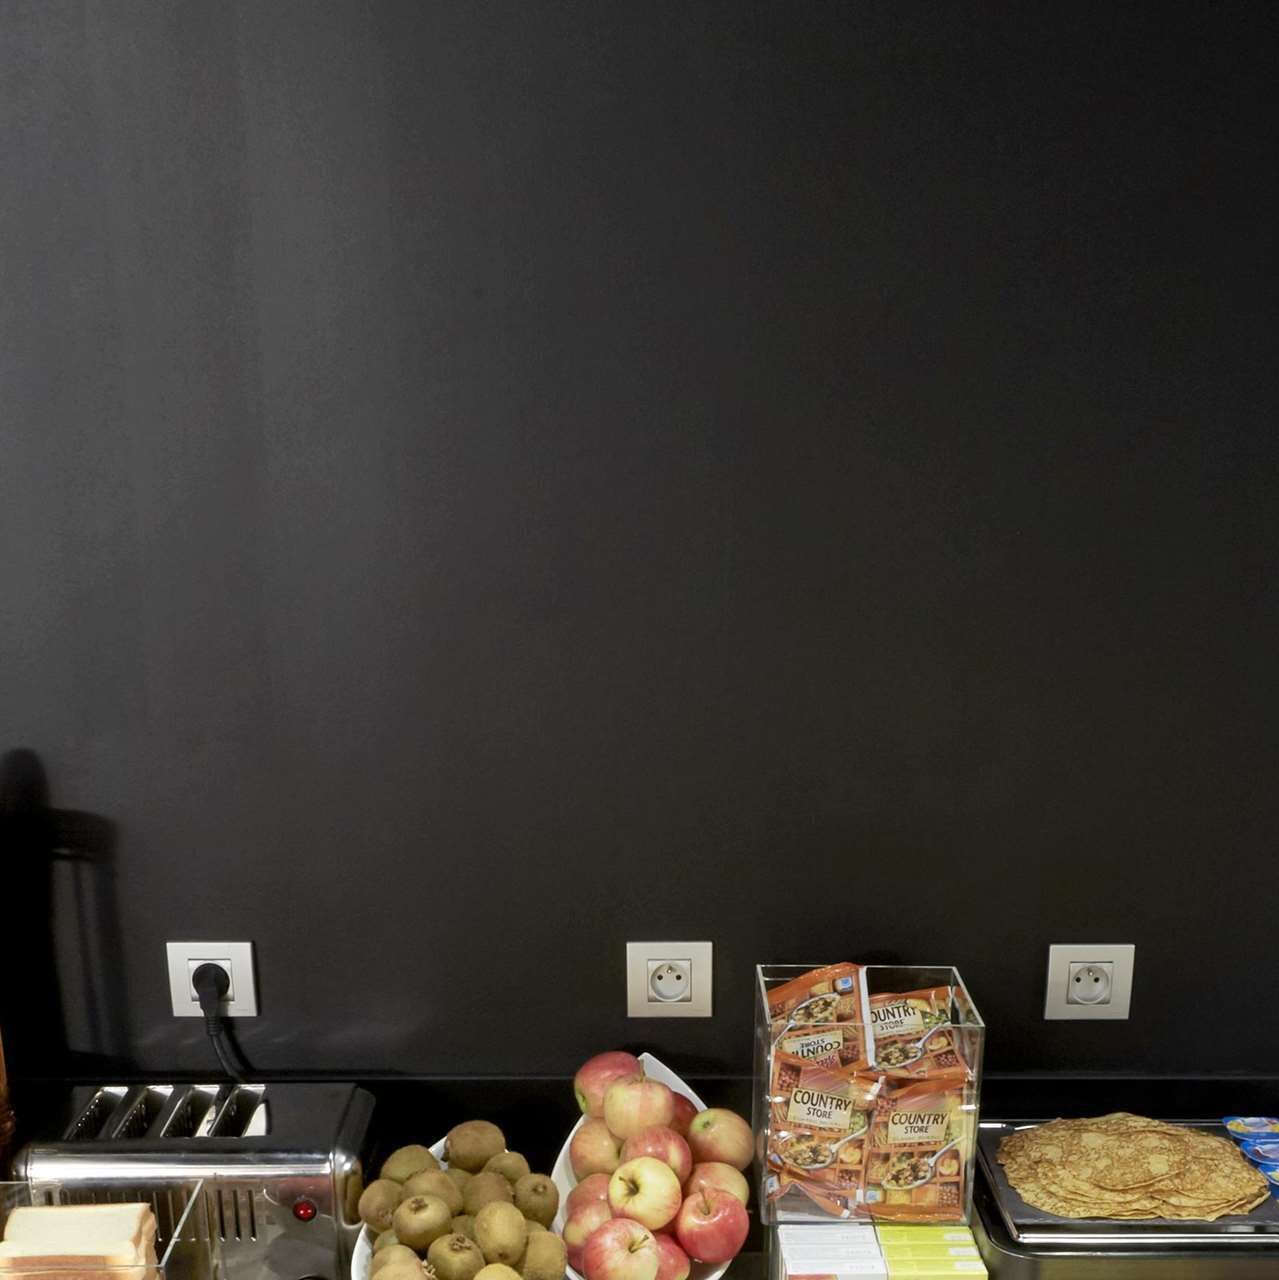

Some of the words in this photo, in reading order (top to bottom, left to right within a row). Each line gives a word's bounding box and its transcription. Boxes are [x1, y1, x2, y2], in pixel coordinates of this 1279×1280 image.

[870, 1004, 917, 1024] OUNTRY
[791, 1041, 841, 1059] COUNT
[799, 1038, 825, 1049] STORE
[793, 1089, 852, 1112] COUNTRY
[806, 1106, 833, 1119] STORE
[891, 1112, 948, 1125] COUNTRY
[904, 1125, 929, 1135] STORE
